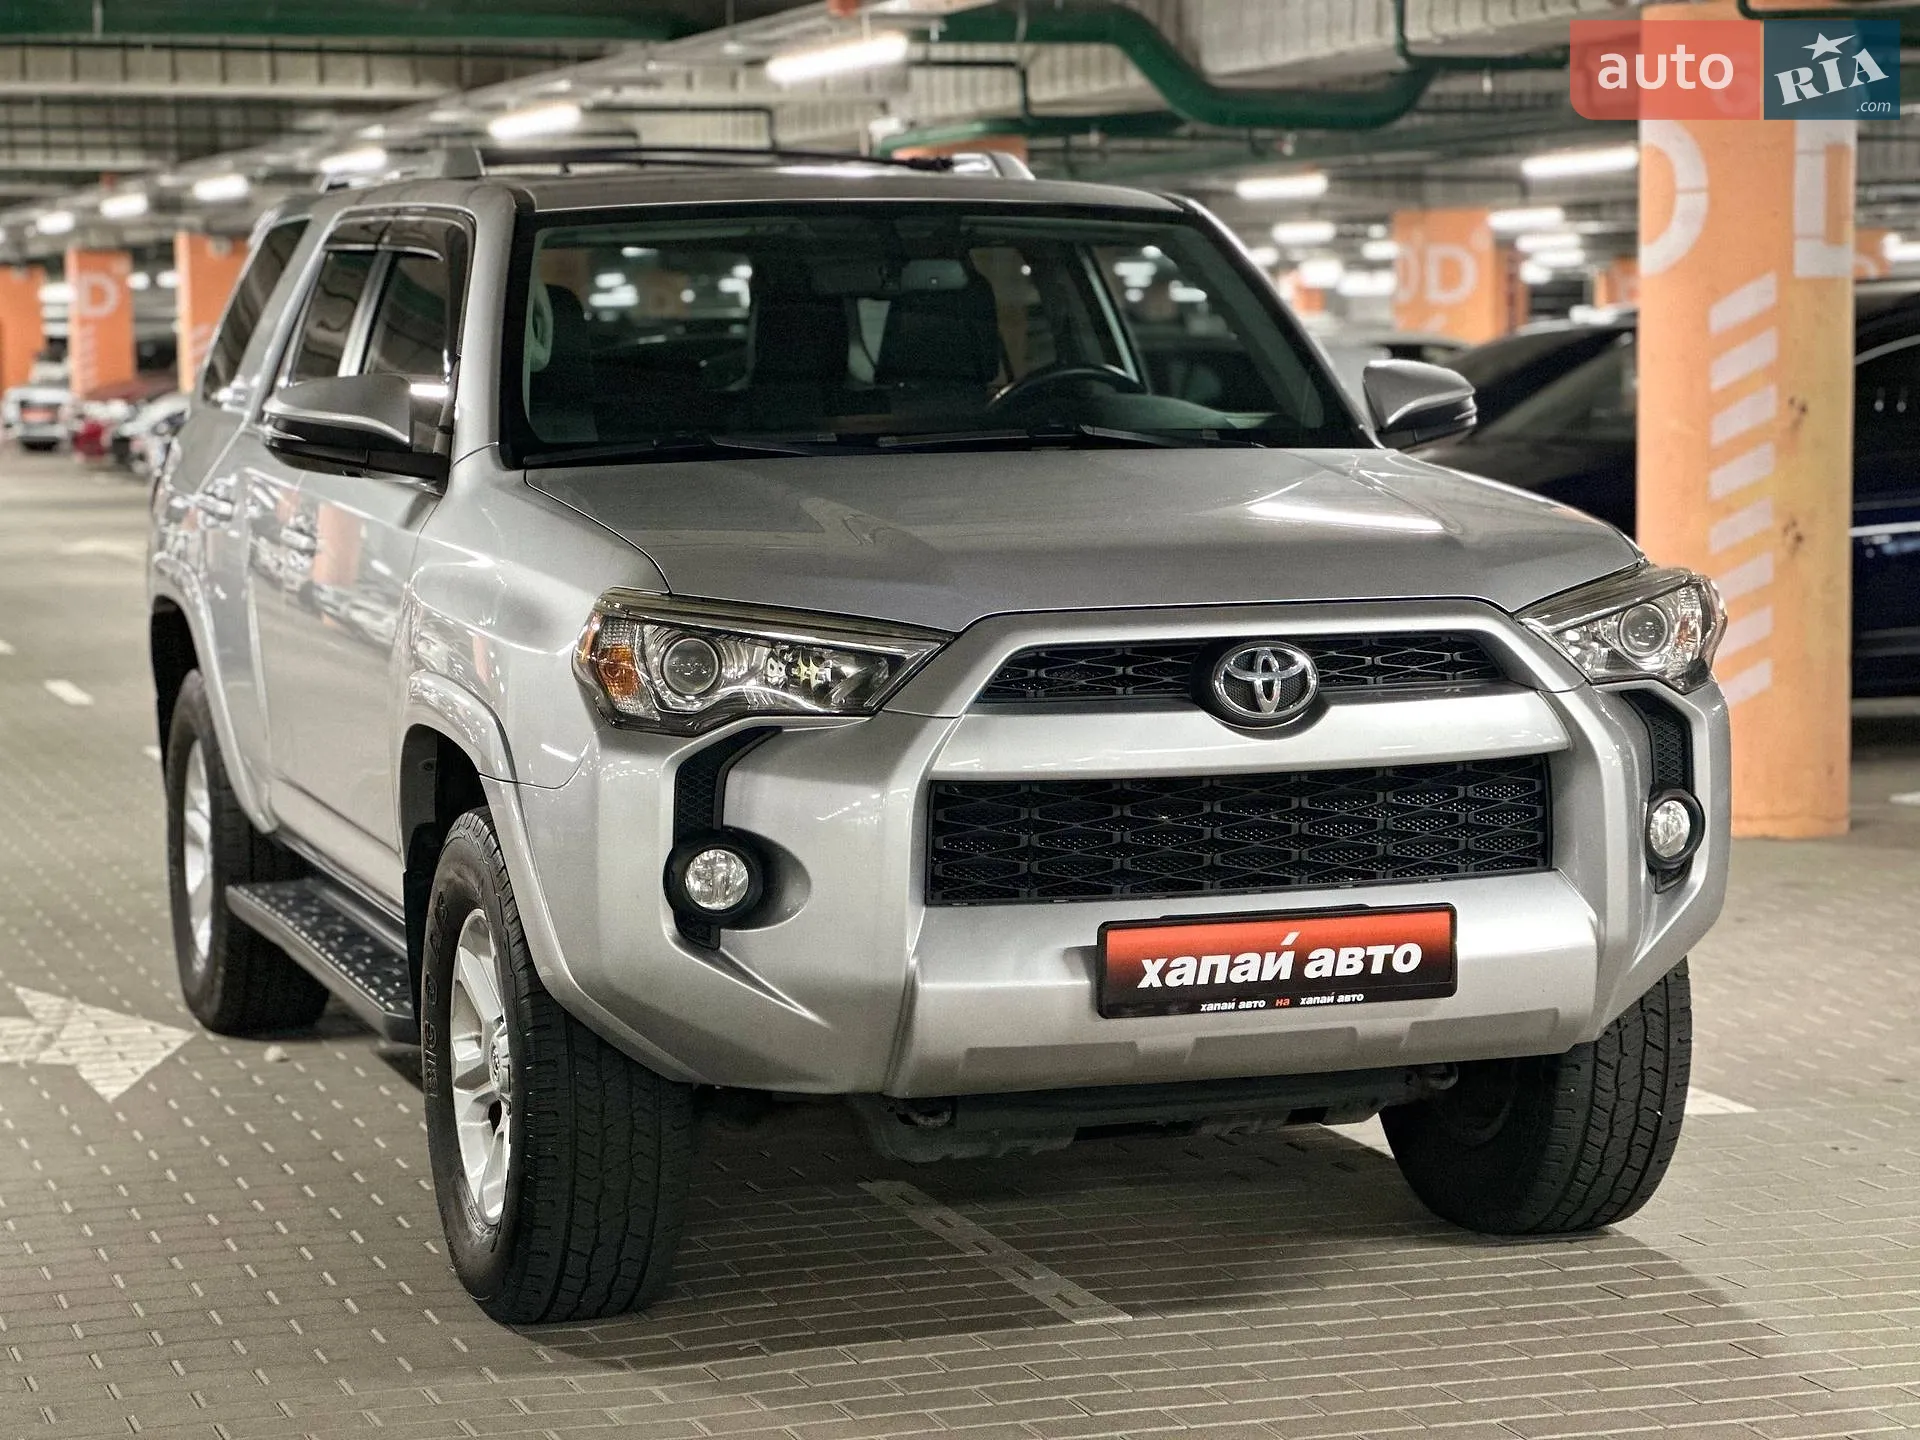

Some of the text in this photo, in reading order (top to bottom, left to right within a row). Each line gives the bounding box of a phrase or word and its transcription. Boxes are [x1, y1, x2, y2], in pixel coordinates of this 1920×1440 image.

[1304, 943, 1422, 979] авто
[1238, 999, 1266, 1010] авто
[1275, 997, 1290, 1007] на
[1336, 993, 1364, 1003] авто
